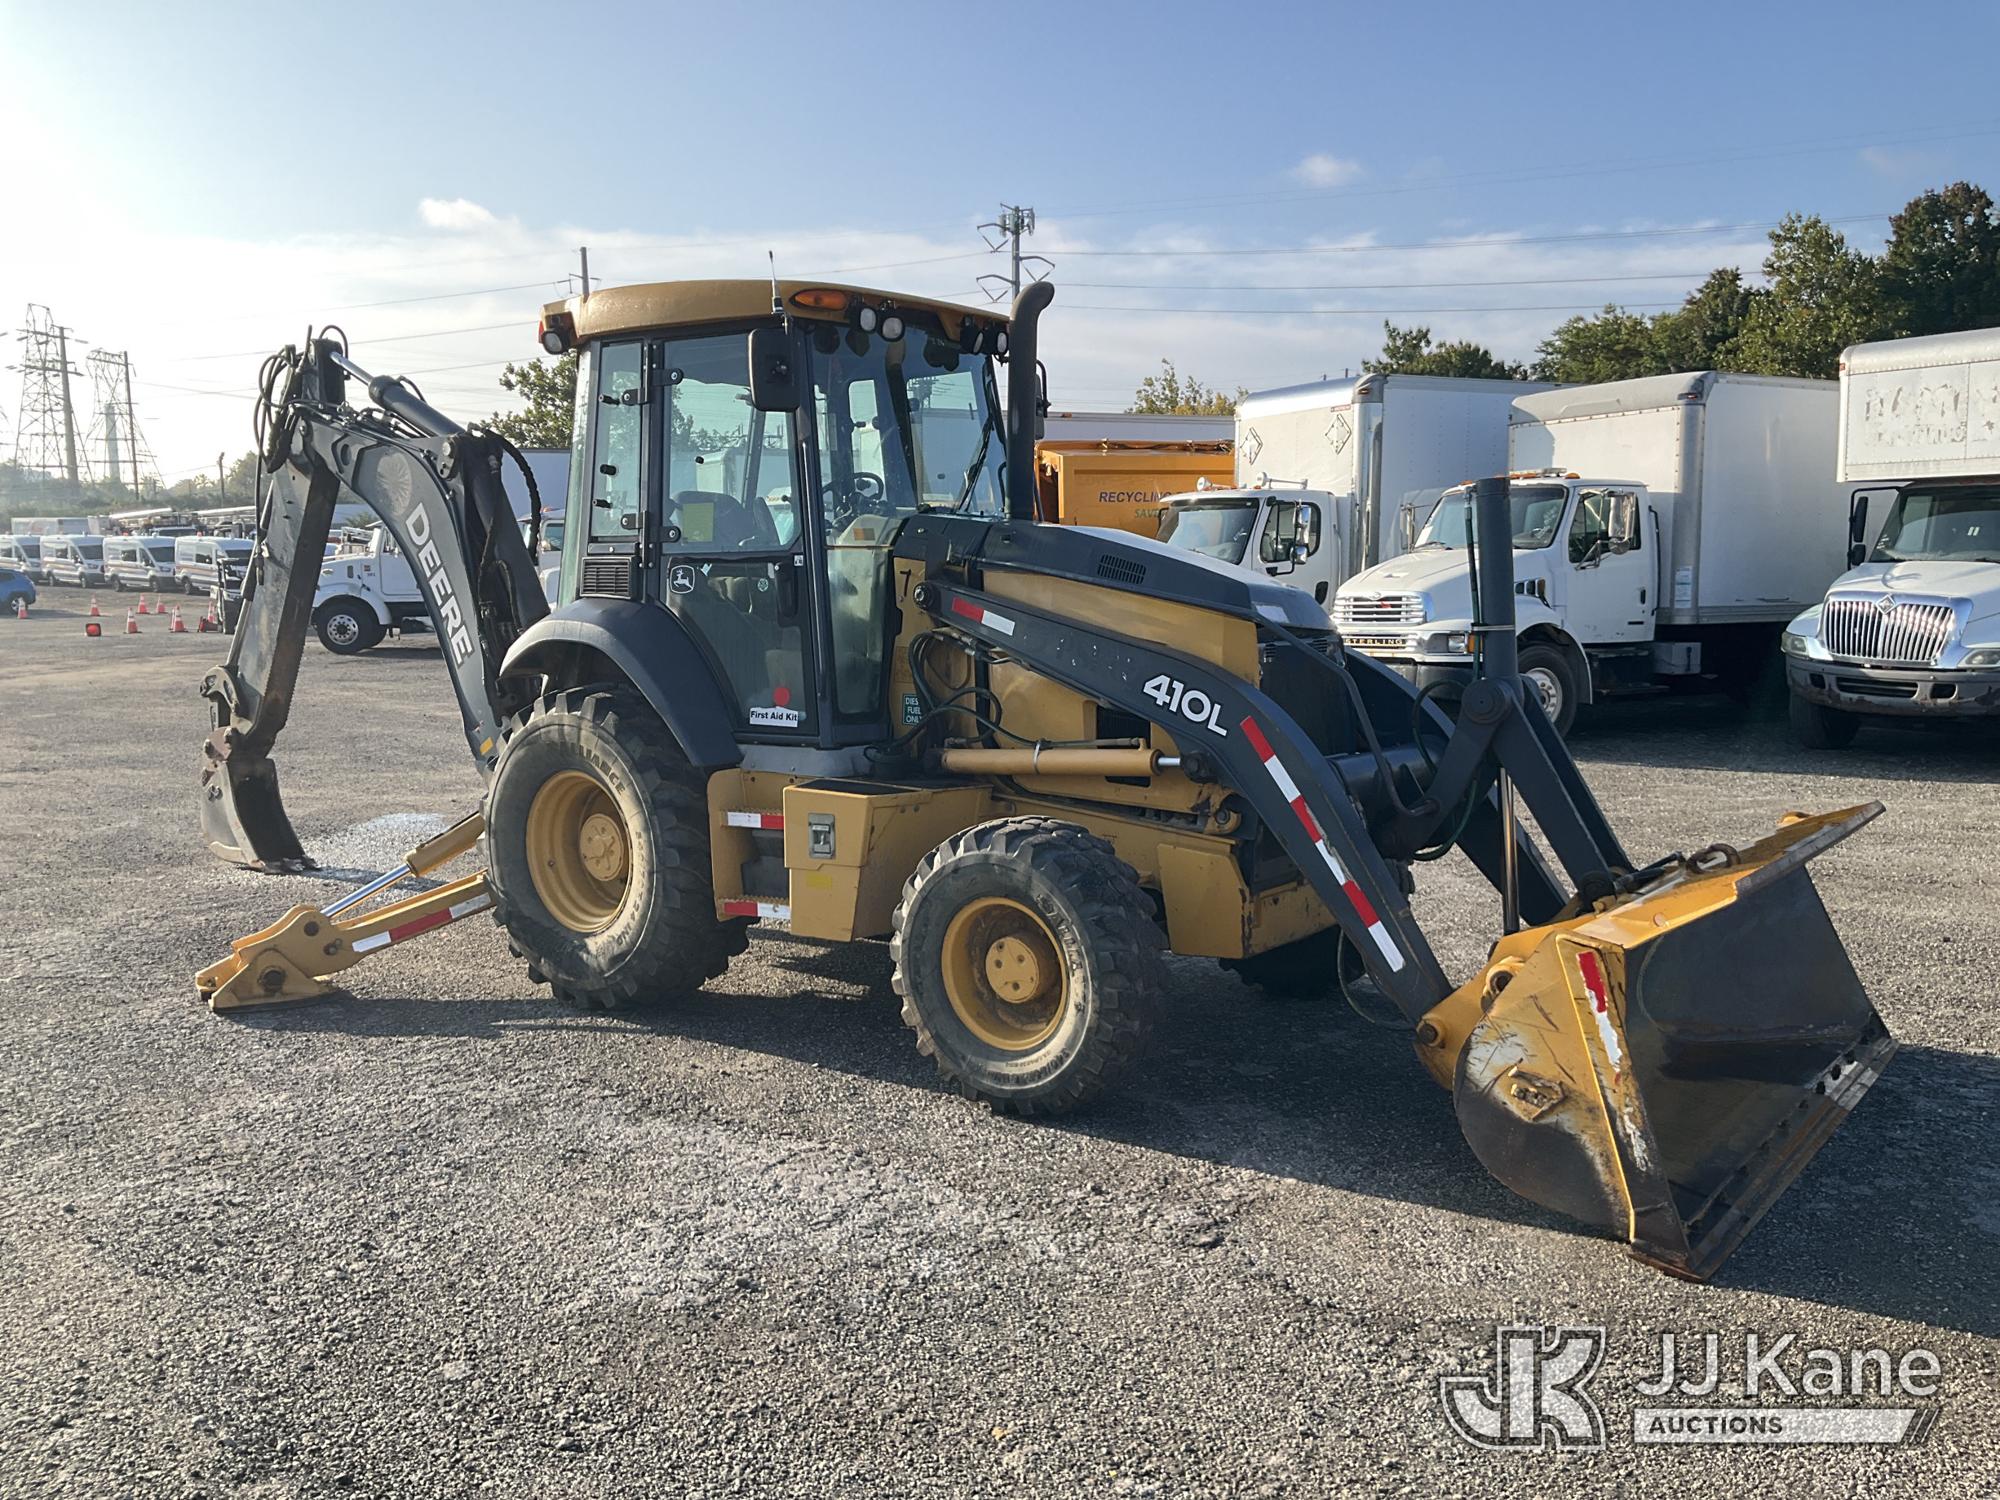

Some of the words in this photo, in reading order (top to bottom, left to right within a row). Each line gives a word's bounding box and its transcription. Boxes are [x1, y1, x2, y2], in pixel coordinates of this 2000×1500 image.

[405, 502, 475, 666] DEERE
[900, 569, 911, 596] 7
[905, 697, 919, 705] DIES
[1143, 674, 1228, 737] 410L
[750, 710, 769, 719] First
[770, 711, 784, 720] Aid
[785, 712, 798, 721] Kit
